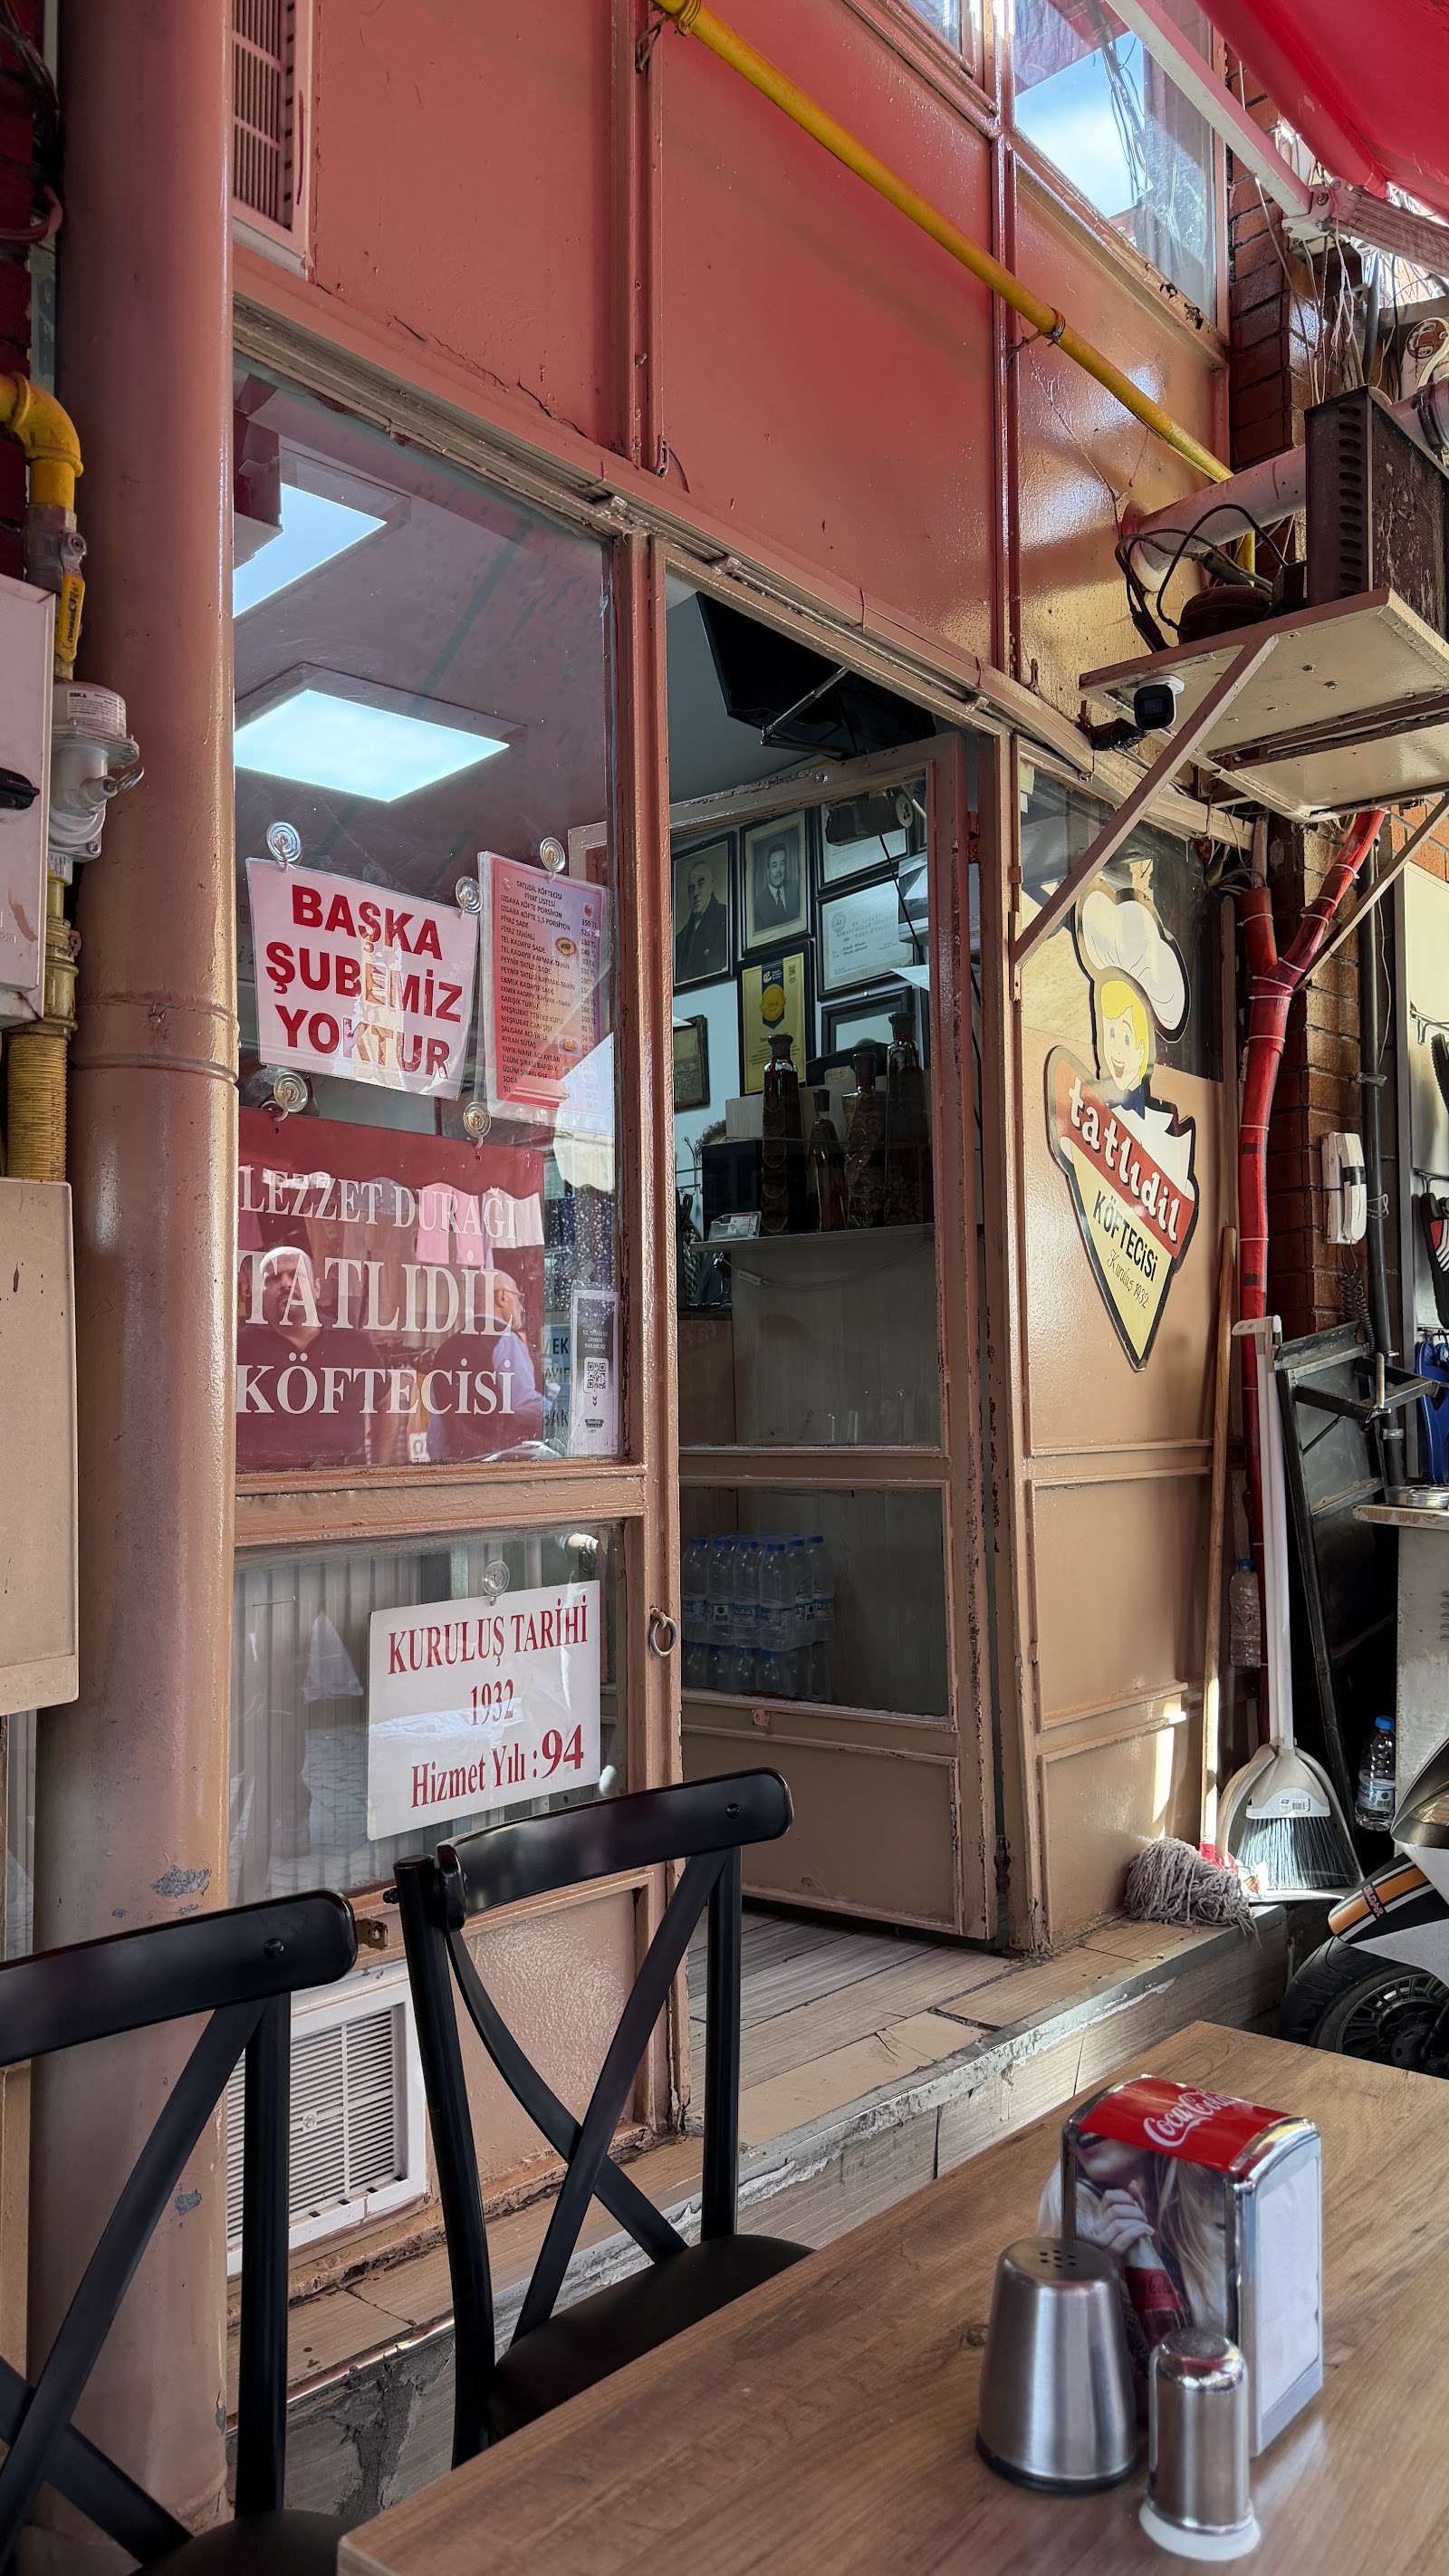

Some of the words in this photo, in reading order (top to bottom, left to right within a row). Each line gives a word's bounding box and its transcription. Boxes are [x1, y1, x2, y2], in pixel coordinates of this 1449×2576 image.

[291, 884, 443, 961] BAŞKA
[515, 918, 529, 929] SADE
[521, 899, 536, 911] KÖFTE
[521, 910, 536, 921] KÖFTE
[501, 936, 510, 944] TEL
[532, 944, 545, 954] SADE
[501, 946, 510, 954] TEL
[264, 941, 464, 1024] ŞUBEMİZ
[501, 976, 519, 986] EKMEK
[274, 1004, 451, 1081] YOKTUR
[238, 1165, 384, 1226] LEZZET
[392, 1186, 517, 1240] DURAĞI
[1092, 1189, 1158, 1283] KÖFTECİSİ
[237, 1248, 513, 1337] TATLIDİL
[1107, 1248, 1135, 1293] Kuruluş
[1133, 1283, 1149, 1309] 1932
[236, 1352, 515, 1416] KÖFTECİSİ
[388, 1615, 504, 1675] KURULUŞ
[510, 1594, 589, 1653] TARİHİ
[470, 1678, 514, 1726] 1932
[410, 1753, 485, 1808] Hizmet
[491, 1743, 526, 1788] Yılı
